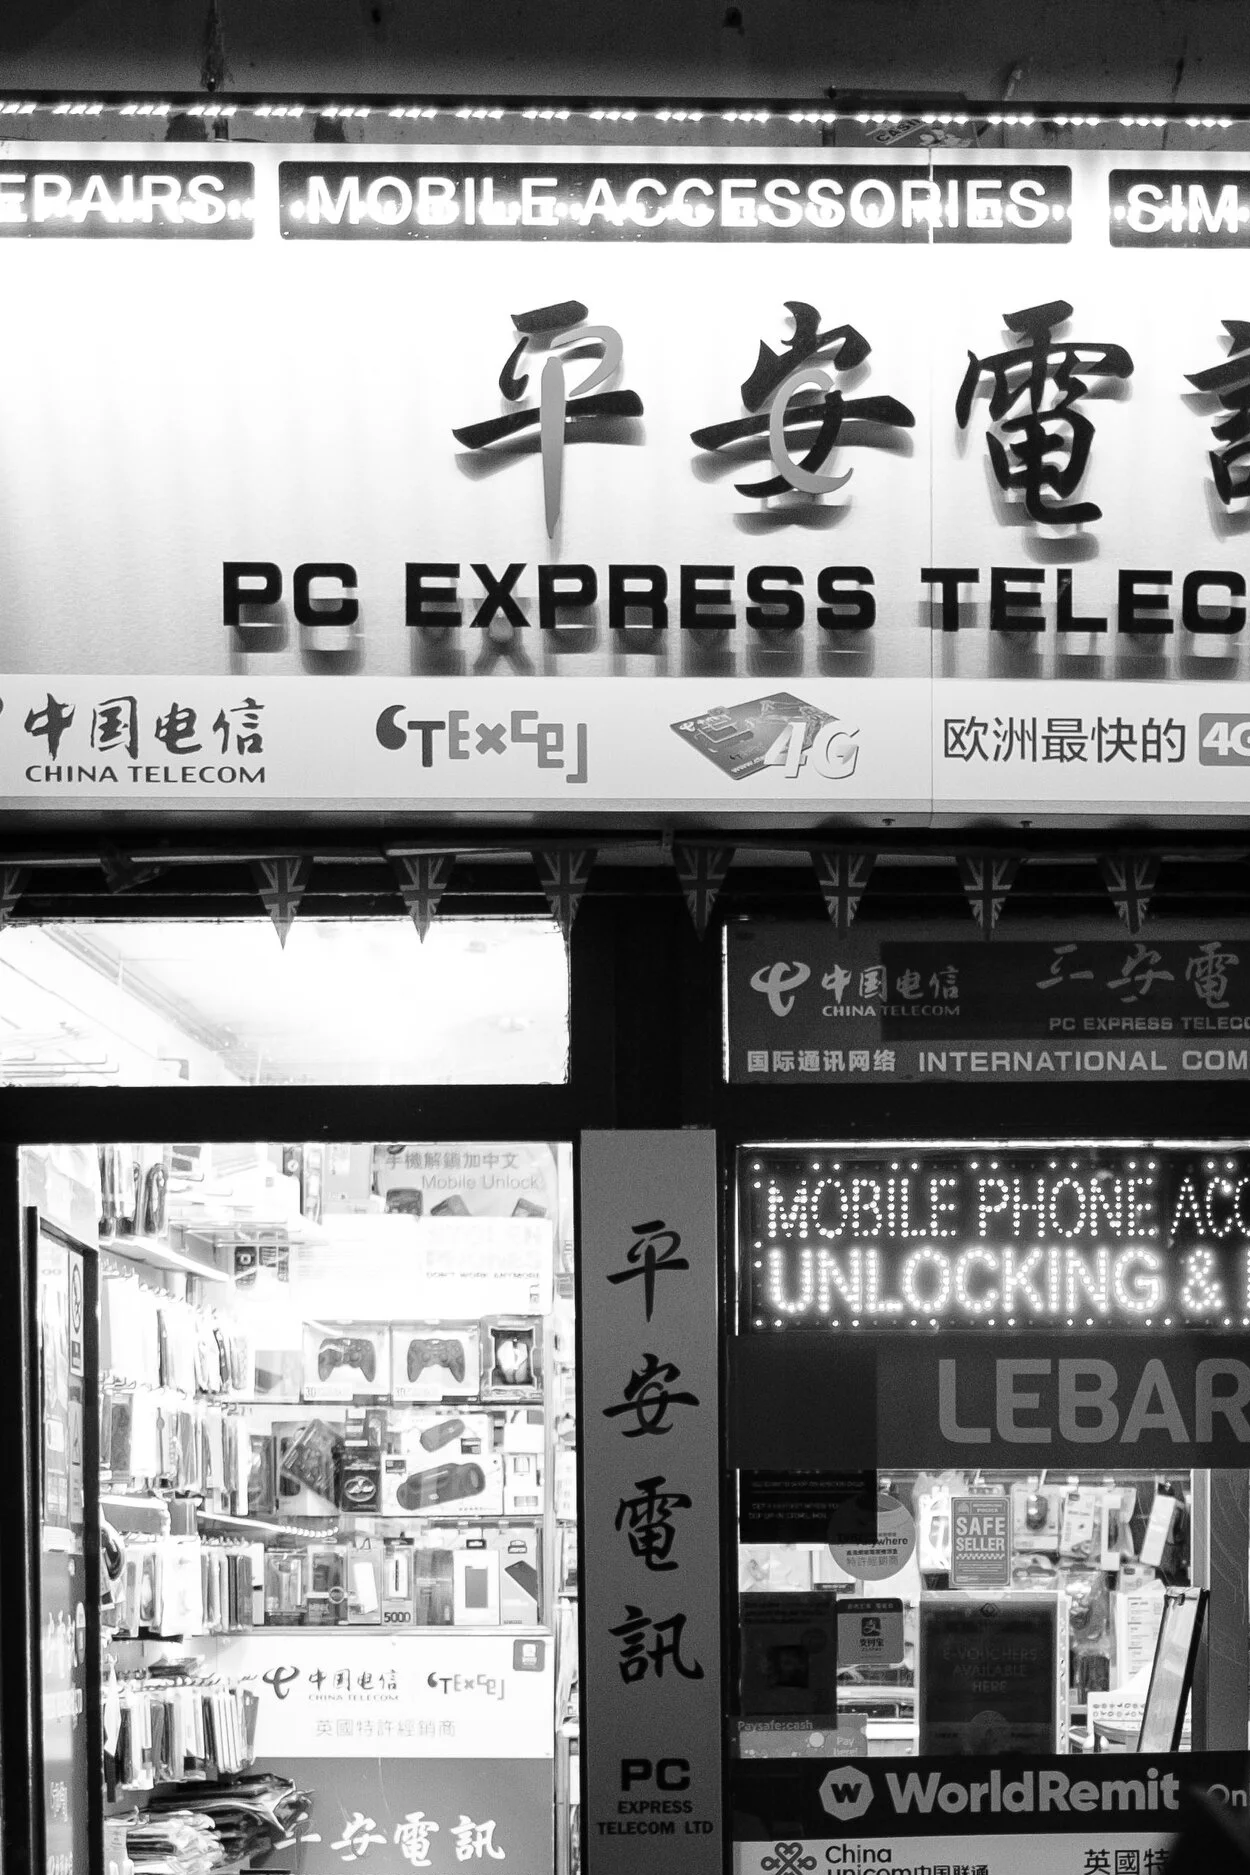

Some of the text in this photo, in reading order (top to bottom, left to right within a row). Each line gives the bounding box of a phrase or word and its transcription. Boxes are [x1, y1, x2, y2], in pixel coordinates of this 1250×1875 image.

[307, 176, 1048, 229] MOBILE ACCESSORIES
[1125, 184, 1241, 234] SIM
[222, 562, 356, 628] PC
[405, 562, 876, 634] EXPRESS
[25, 692, 266, 761] 中国电信
[941, 716, 1187, 765] 欧洲最快的
[763, 718, 861, 780] 4G
[25, 765, 267, 784] CHINA TELECOM
[820, 961, 960, 1002] 中国电信
[821, 1004, 961, 1018] CHINA TELECOM
[1048, 1016, 1078, 1031] PC
[1083, 1016, 1175, 1031] EXPRESS
[746, 1049, 897, 1074] 国际通讯网络
[918, 1051, 1168, 1073] INTERNATIONAL
[422, 1173, 540, 1190] Mobile Unlock
[766, 1177, 957, 1238] MOBILE
[978, 1177, 1156, 1237] PHONE
[764, 1247, 1165, 1314] UNLOCKING
[1181, 1247, 1224, 1313] &
[602, 1220, 706, 1687] 平安電訊
[955, 1516, 1006, 1536] SAFE
[955, 1536, 1006, 1552] SELLER
[383, 1611, 412, 1624] 5000
[308, 1667, 399, 1692] 中国电信
[620, 1757, 692, 1793] PC
[884, 1767, 1181, 1815] WorldRemit
[616, 1799, 694, 1816] EXPRESS
[597, 1820, 714, 1837] TELECOM LTD
[824, 1844, 893, 1865] China
